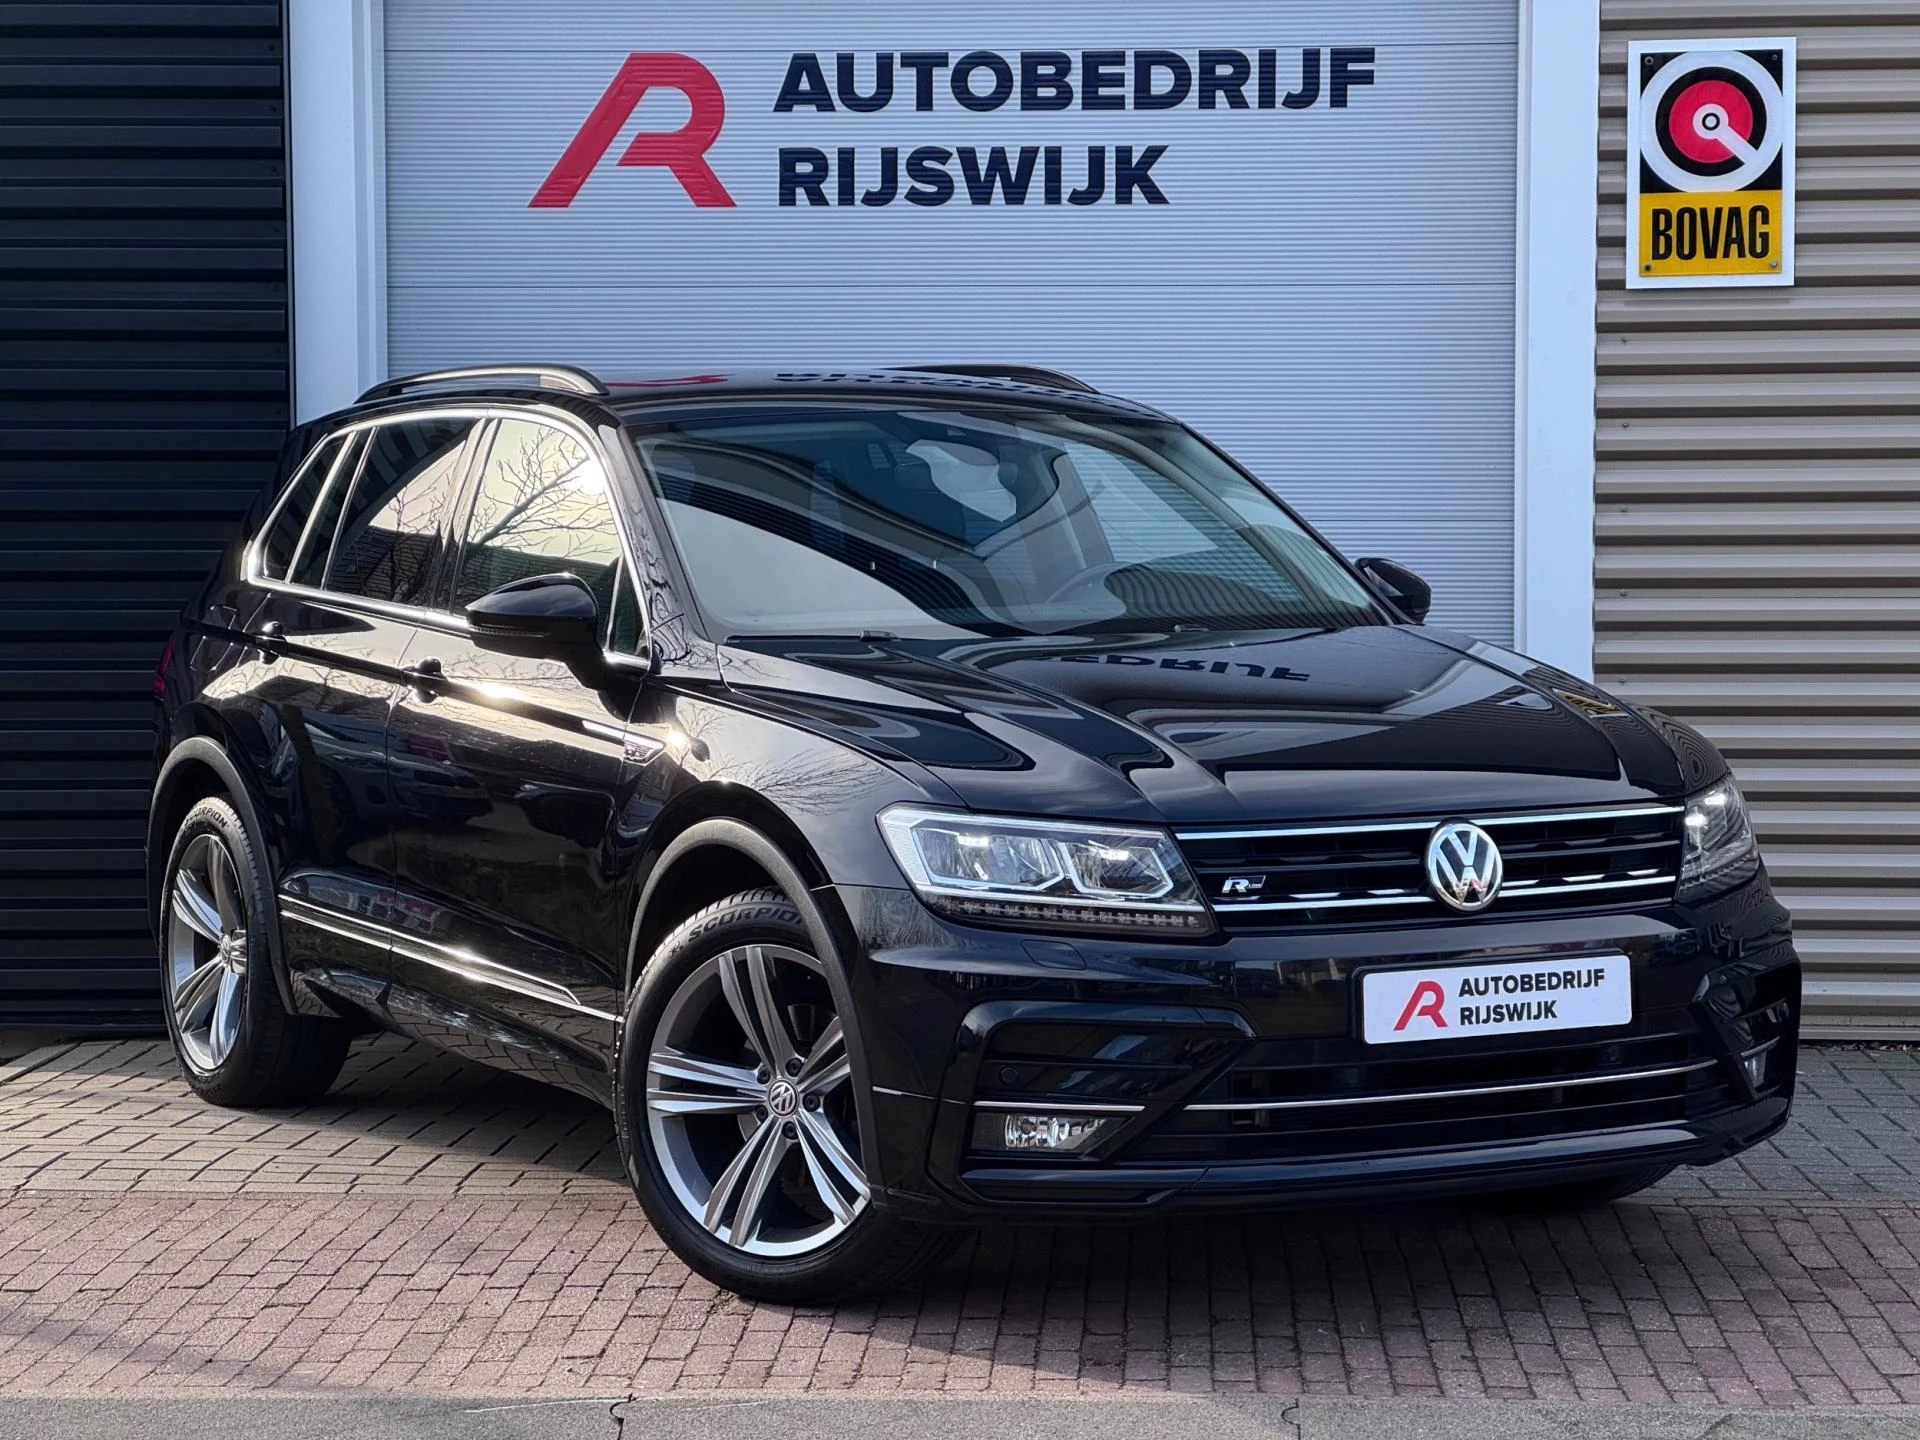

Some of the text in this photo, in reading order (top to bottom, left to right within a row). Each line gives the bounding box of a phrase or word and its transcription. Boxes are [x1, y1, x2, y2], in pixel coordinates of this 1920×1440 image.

[773, 47, 1375, 113] AUTOBEDRIJF
[777, 144, 1172, 207] RIJSWIJK
[1651, 204, 1770, 261] BOVAG
[1458, 968, 1605, 997] AUTOBEDRIJF
[1459, 1000, 1558, 1026] RIJSWIJK
